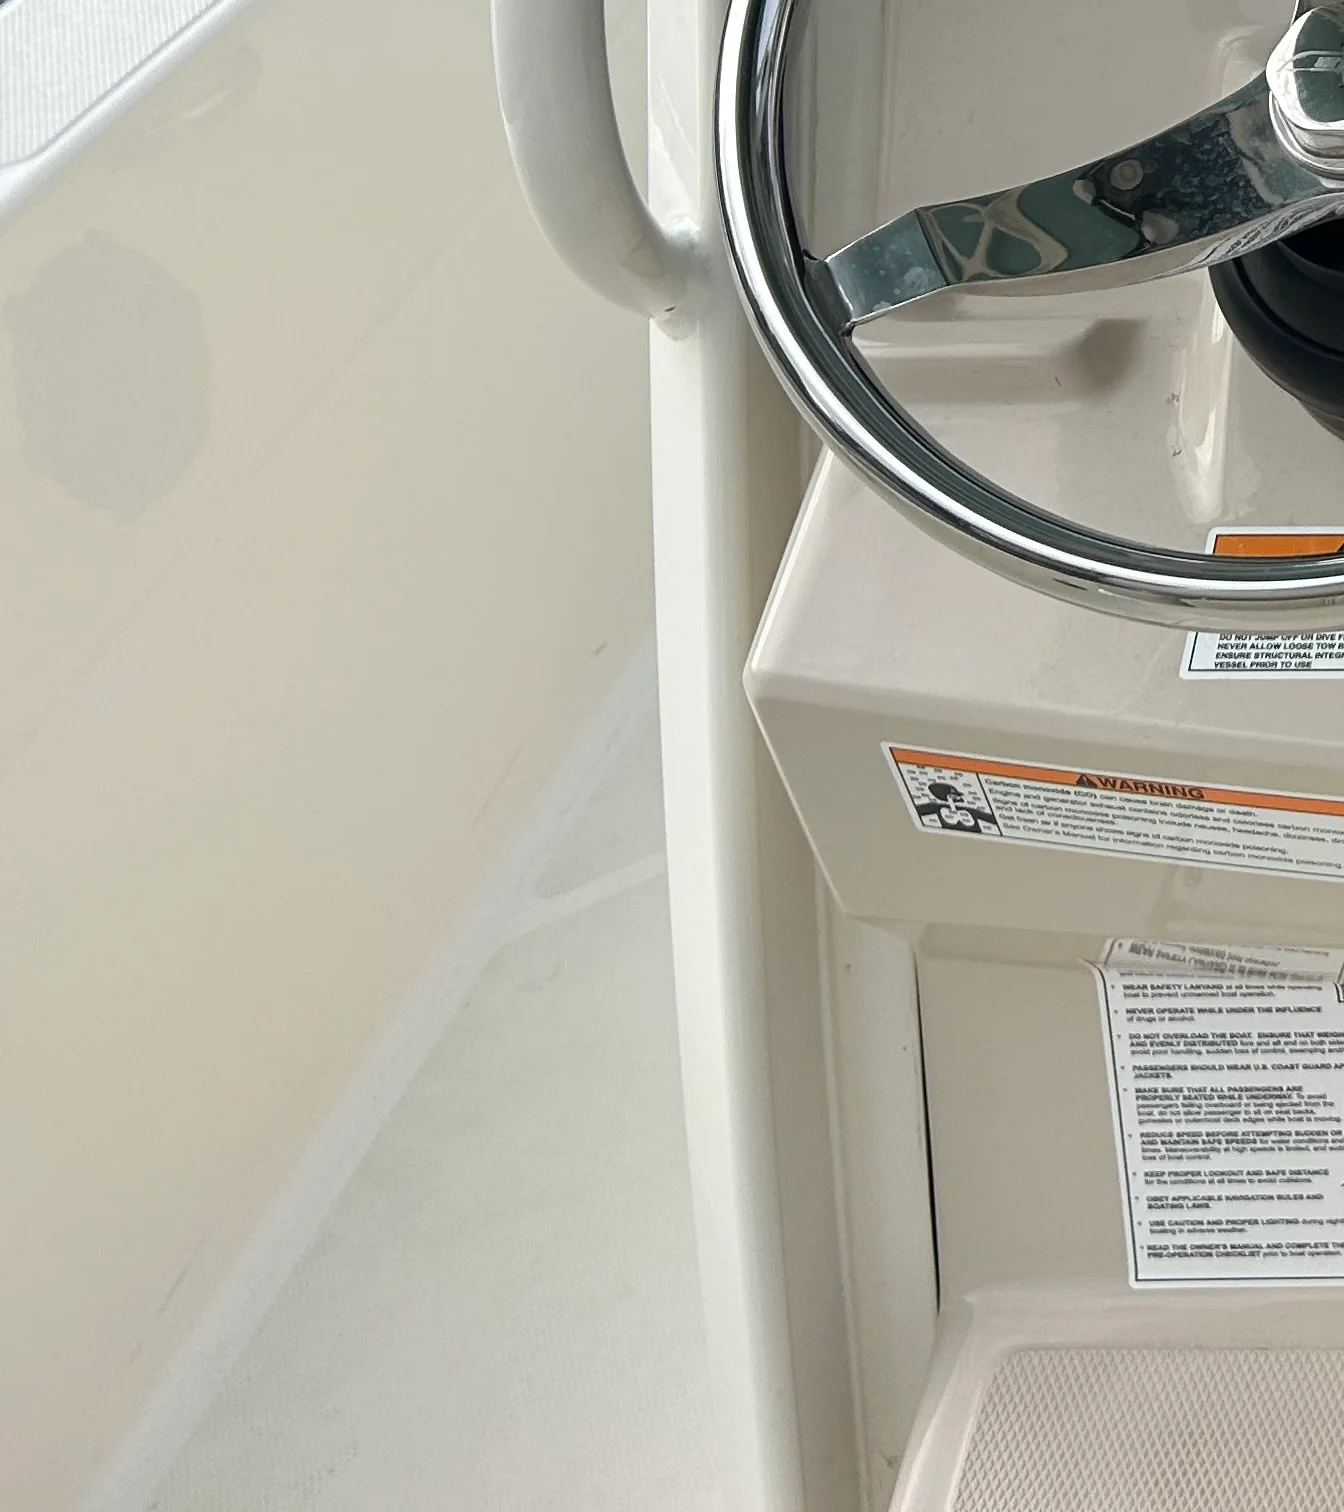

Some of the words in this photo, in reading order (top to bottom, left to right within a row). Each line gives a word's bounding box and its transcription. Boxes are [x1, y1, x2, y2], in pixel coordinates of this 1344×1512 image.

[1217, 642, 1247, 650] NEVER
[1249, 642, 1281, 650] ALLOW
[1283, 642, 1313, 650] LOOSE
[1316, 642, 1336, 650] TOW
[1215, 651, 1251, 659] ENSURE
[1254, 651, 1312, 659] STRUCTURAL
[1214, 660, 1246, 668] VESSEL
[1249, 660, 1277, 668] PRIOR
[1280, 660, 1292, 668] TO
[1294, 660, 1312, 668] USE
[1097, 777, 1205, 799] WARNING
